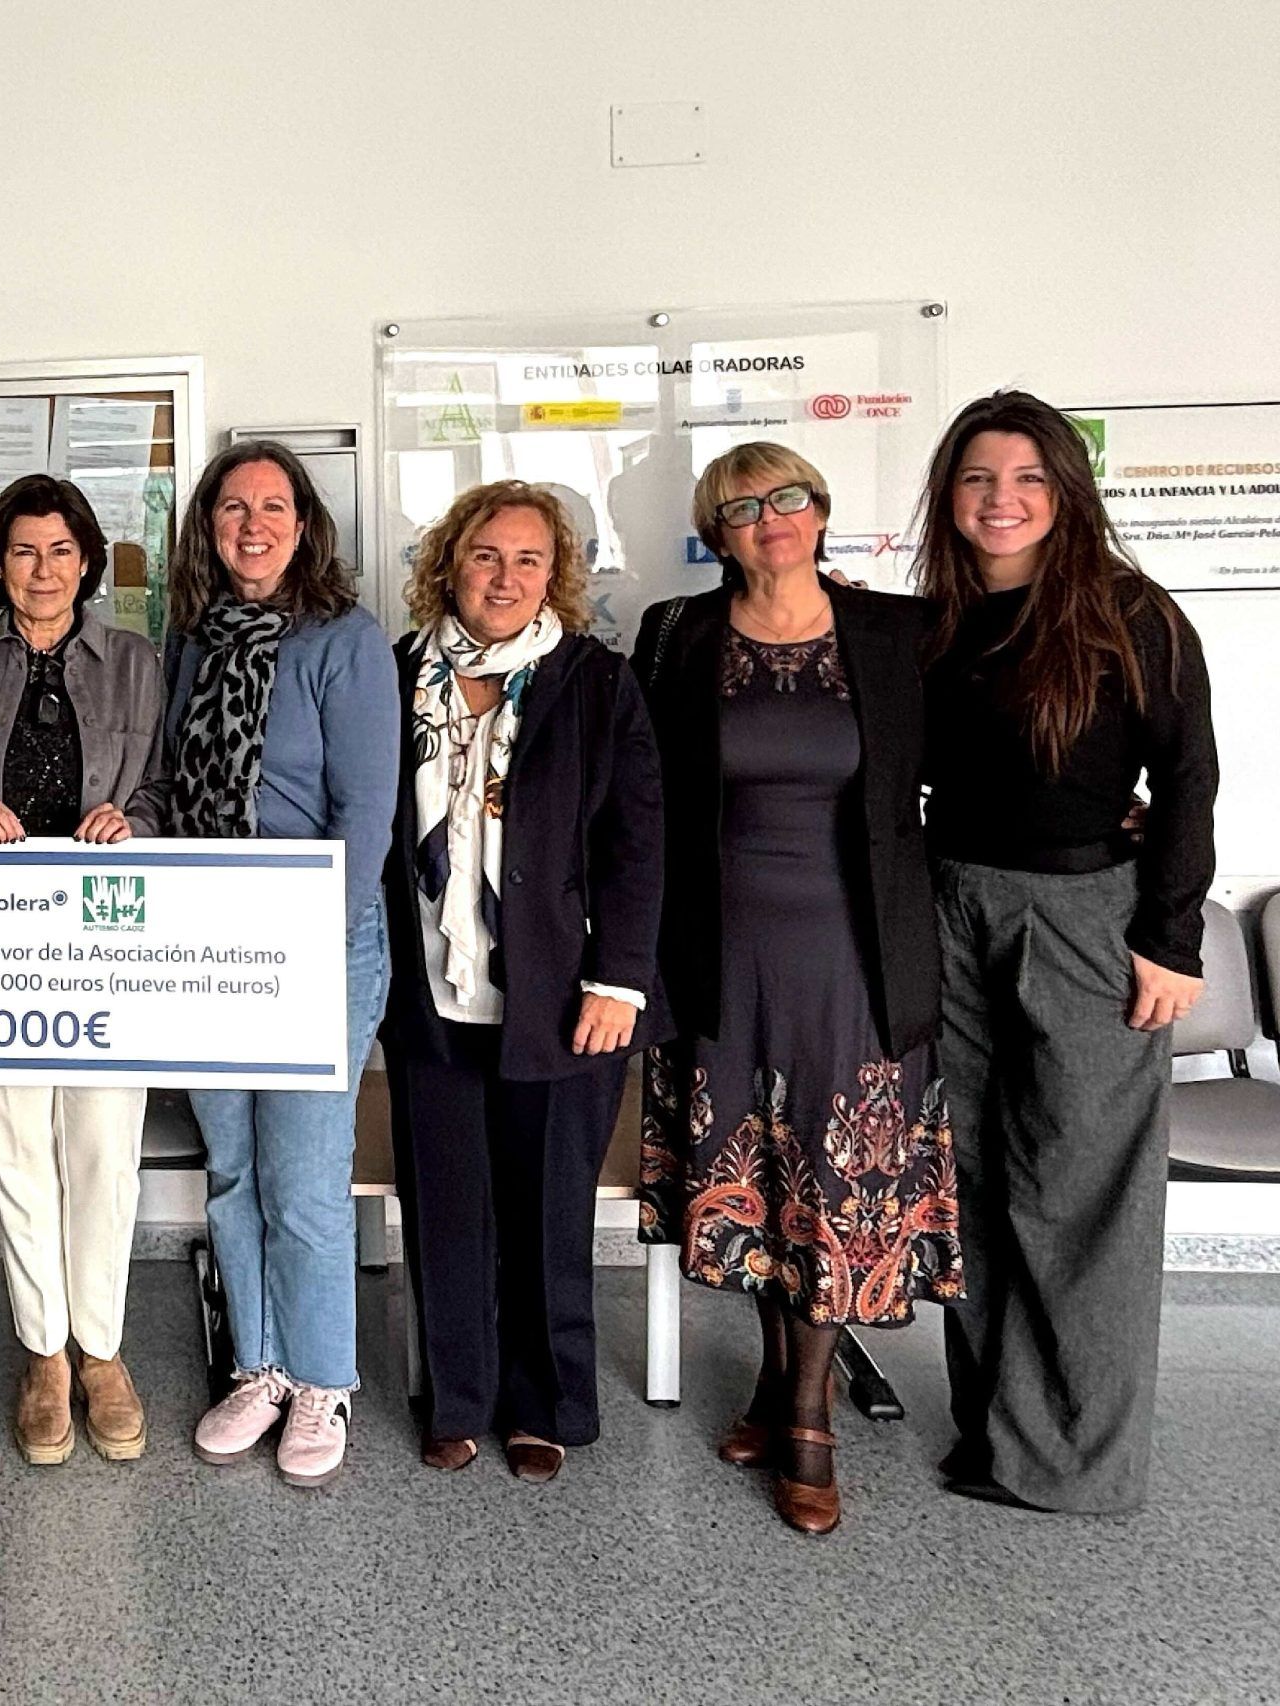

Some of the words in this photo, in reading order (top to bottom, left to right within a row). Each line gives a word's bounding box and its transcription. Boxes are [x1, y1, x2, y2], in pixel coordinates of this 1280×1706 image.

[523, 362, 629, 380] ENTIDADES
[634, 355, 805, 376] COLABORADORAS
[866, 407, 902, 417] ONCE
[1123, 465, 1180, 478] CENTRO
[1184, 465, 1205, 476] DE
[1207, 463, 1280, 476] RECURSOS
[1129, 487, 1138, 497] A
[1141, 487, 1156, 497] LA
[1159, 485, 1215, 497] INFANCIA
[1219, 485, 1227, 495] Y
[1231, 484, 1246, 495] LA
[1193, 529, 1216, 541] José
[82, 924, 119, 932] AUTISMO
[38, 941, 63, 961] de
[68, 942, 84, 961] la
[88, 944, 196, 963] Asociación
[200, 945, 286, 965] Autismo
[47, 977, 105, 992] euros
[109, 972, 177, 996] (nueve
[182, 974, 211, 994] mil
[217, 975, 280, 997] euros)
